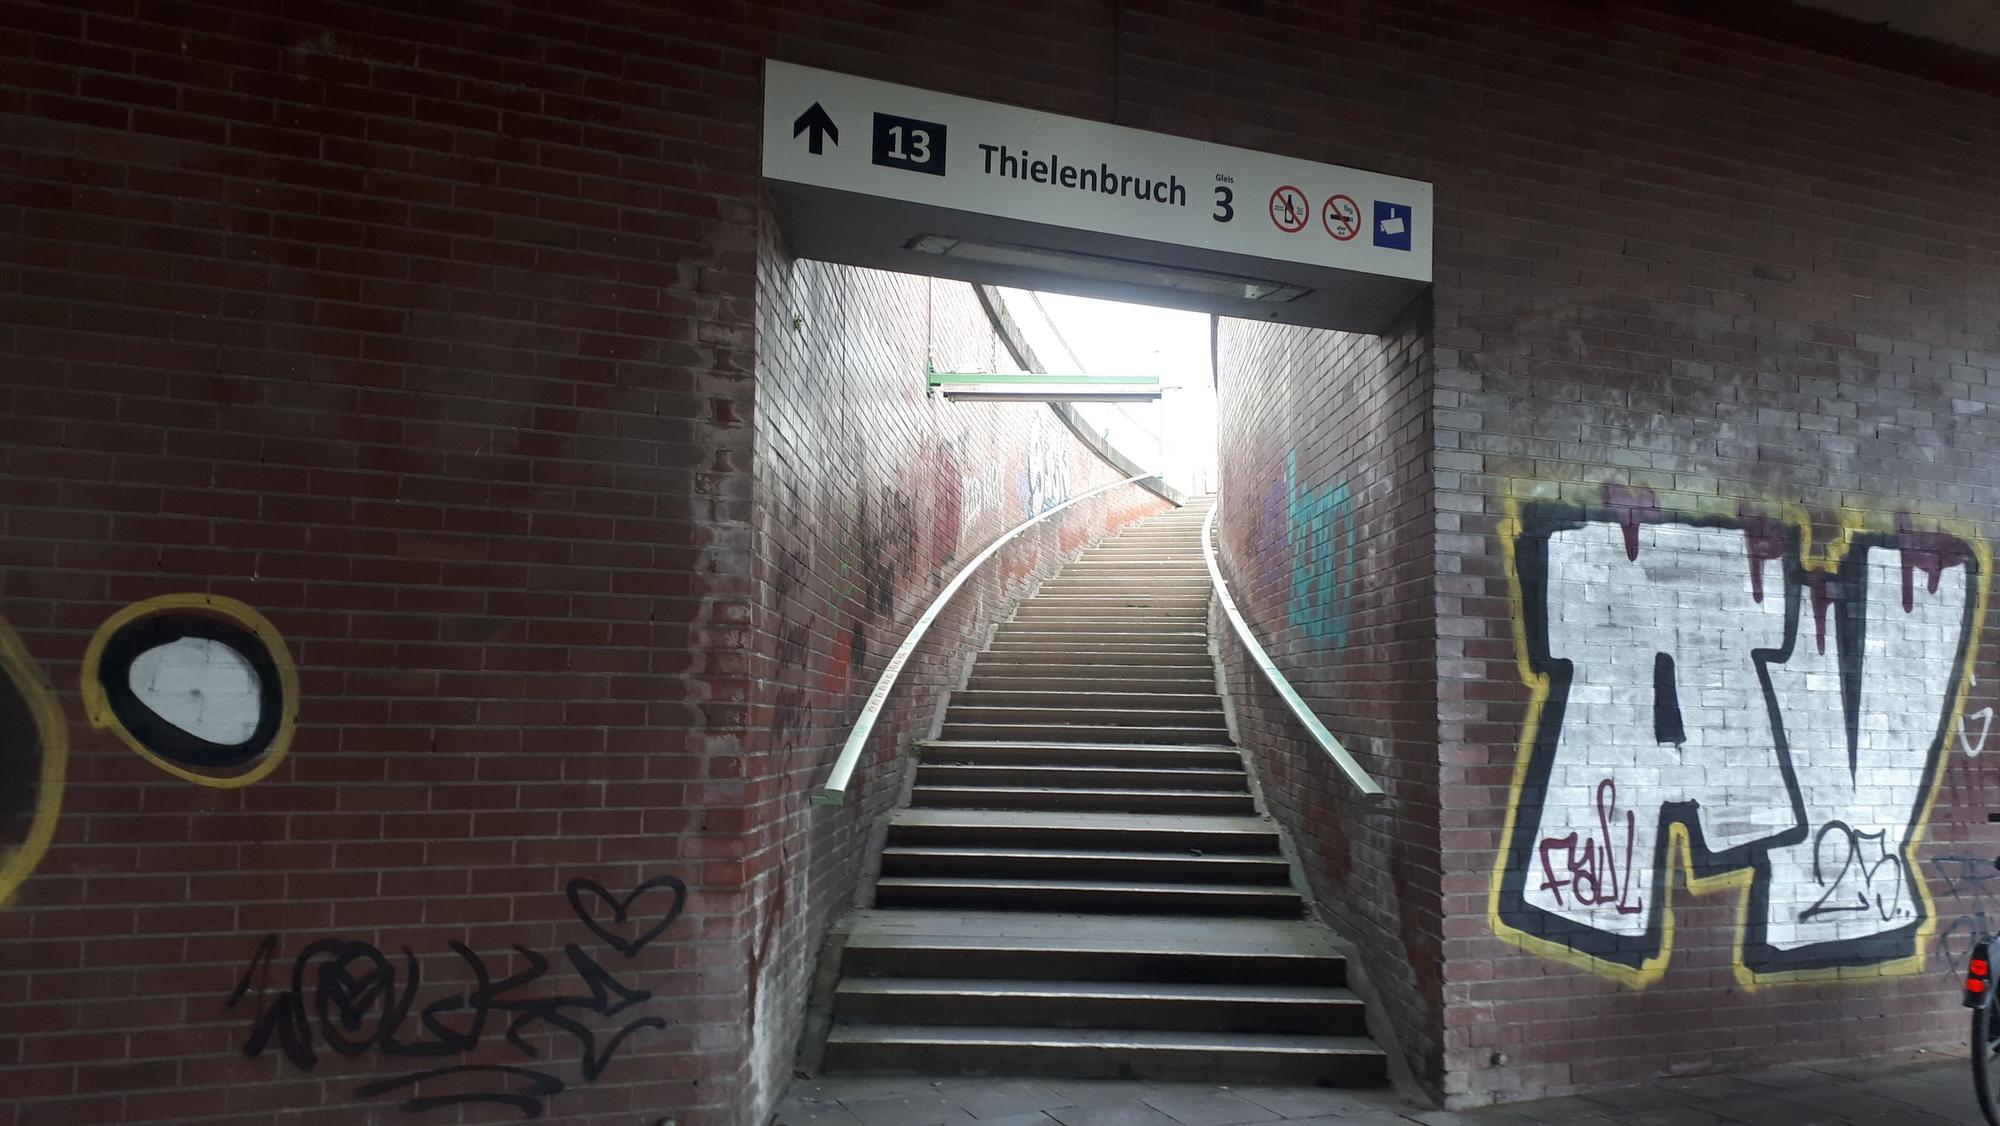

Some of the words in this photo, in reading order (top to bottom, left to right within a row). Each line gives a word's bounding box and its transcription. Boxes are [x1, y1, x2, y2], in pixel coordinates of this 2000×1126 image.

[888, 125, 931, 164] 13
[978, 143, 1187, 207] Thielenbruch
[1215, 172, 1235, 184] Gleis
[1212, 185, 1235, 223] 3
